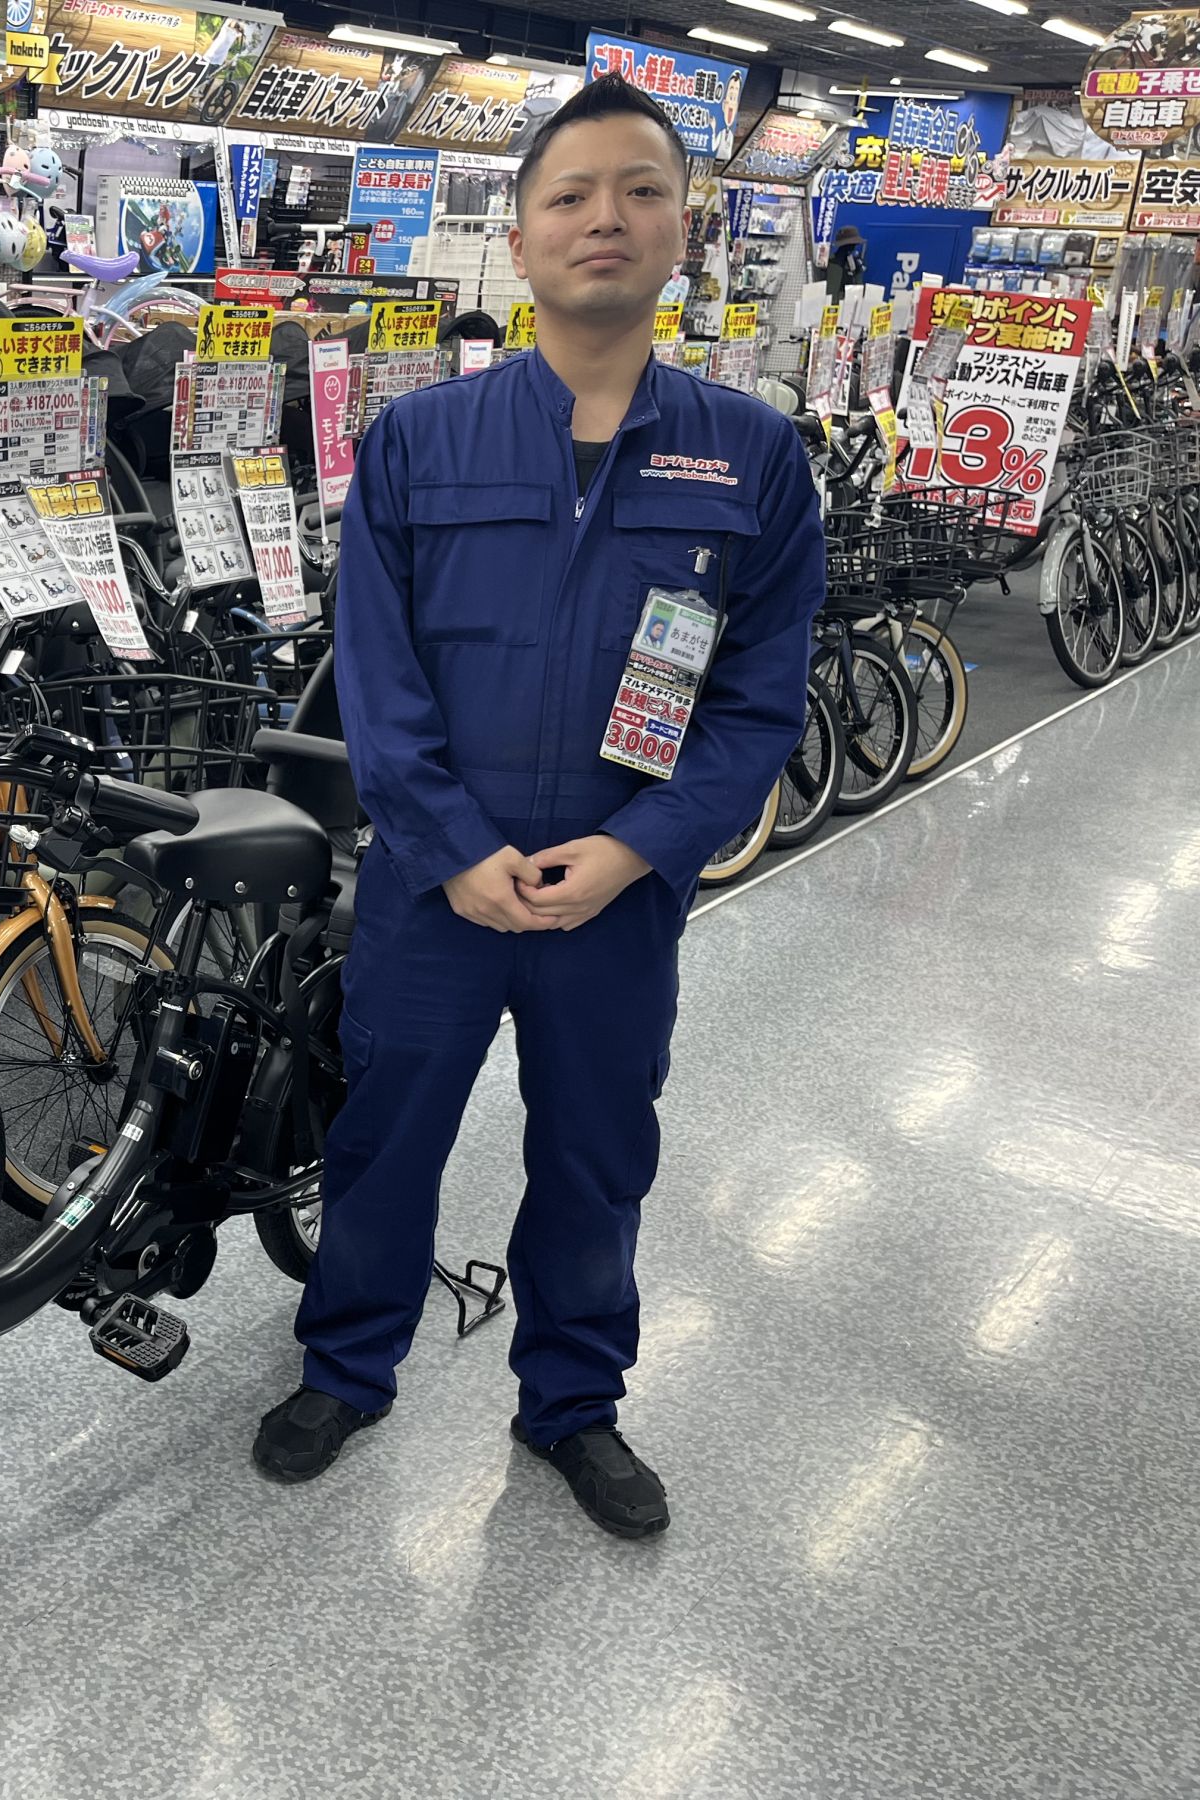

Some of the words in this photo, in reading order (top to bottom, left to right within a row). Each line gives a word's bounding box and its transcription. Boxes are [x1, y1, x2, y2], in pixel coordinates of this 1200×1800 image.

[240, 63, 390, 130] 自転車バスケット
[407, 88, 528, 143] バスケットカバー
[1102, 100, 1187, 129] 自転車
[358, 158, 434, 170] こども自転車専用
[248, 147, 263, 214] バスケット
[357, 171, 433, 191] 適正身長計
[1005, 165, 1131, 204] サイクルカバー
[359, 260, 371, 268] 24
[215, 321, 271, 339] いますぐ試乗
[3, 334, 81, 355] いますぐ試乗
[14, 356, 69, 374] できます!
[973, 351, 1046, 369] ブリヂストン
[26, 393, 74, 412] ¥187,000
[322, 418, 335, 470] モデル
[650, 454, 730, 473] ヨドバシカメラ
[639, 469, 738, 485] www.yodobashi.com
[670, 627, 709, 650] あまがせ
[618, 687, 690, 725] 新規ご入会
[605, 721, 678, 766] 3,000
